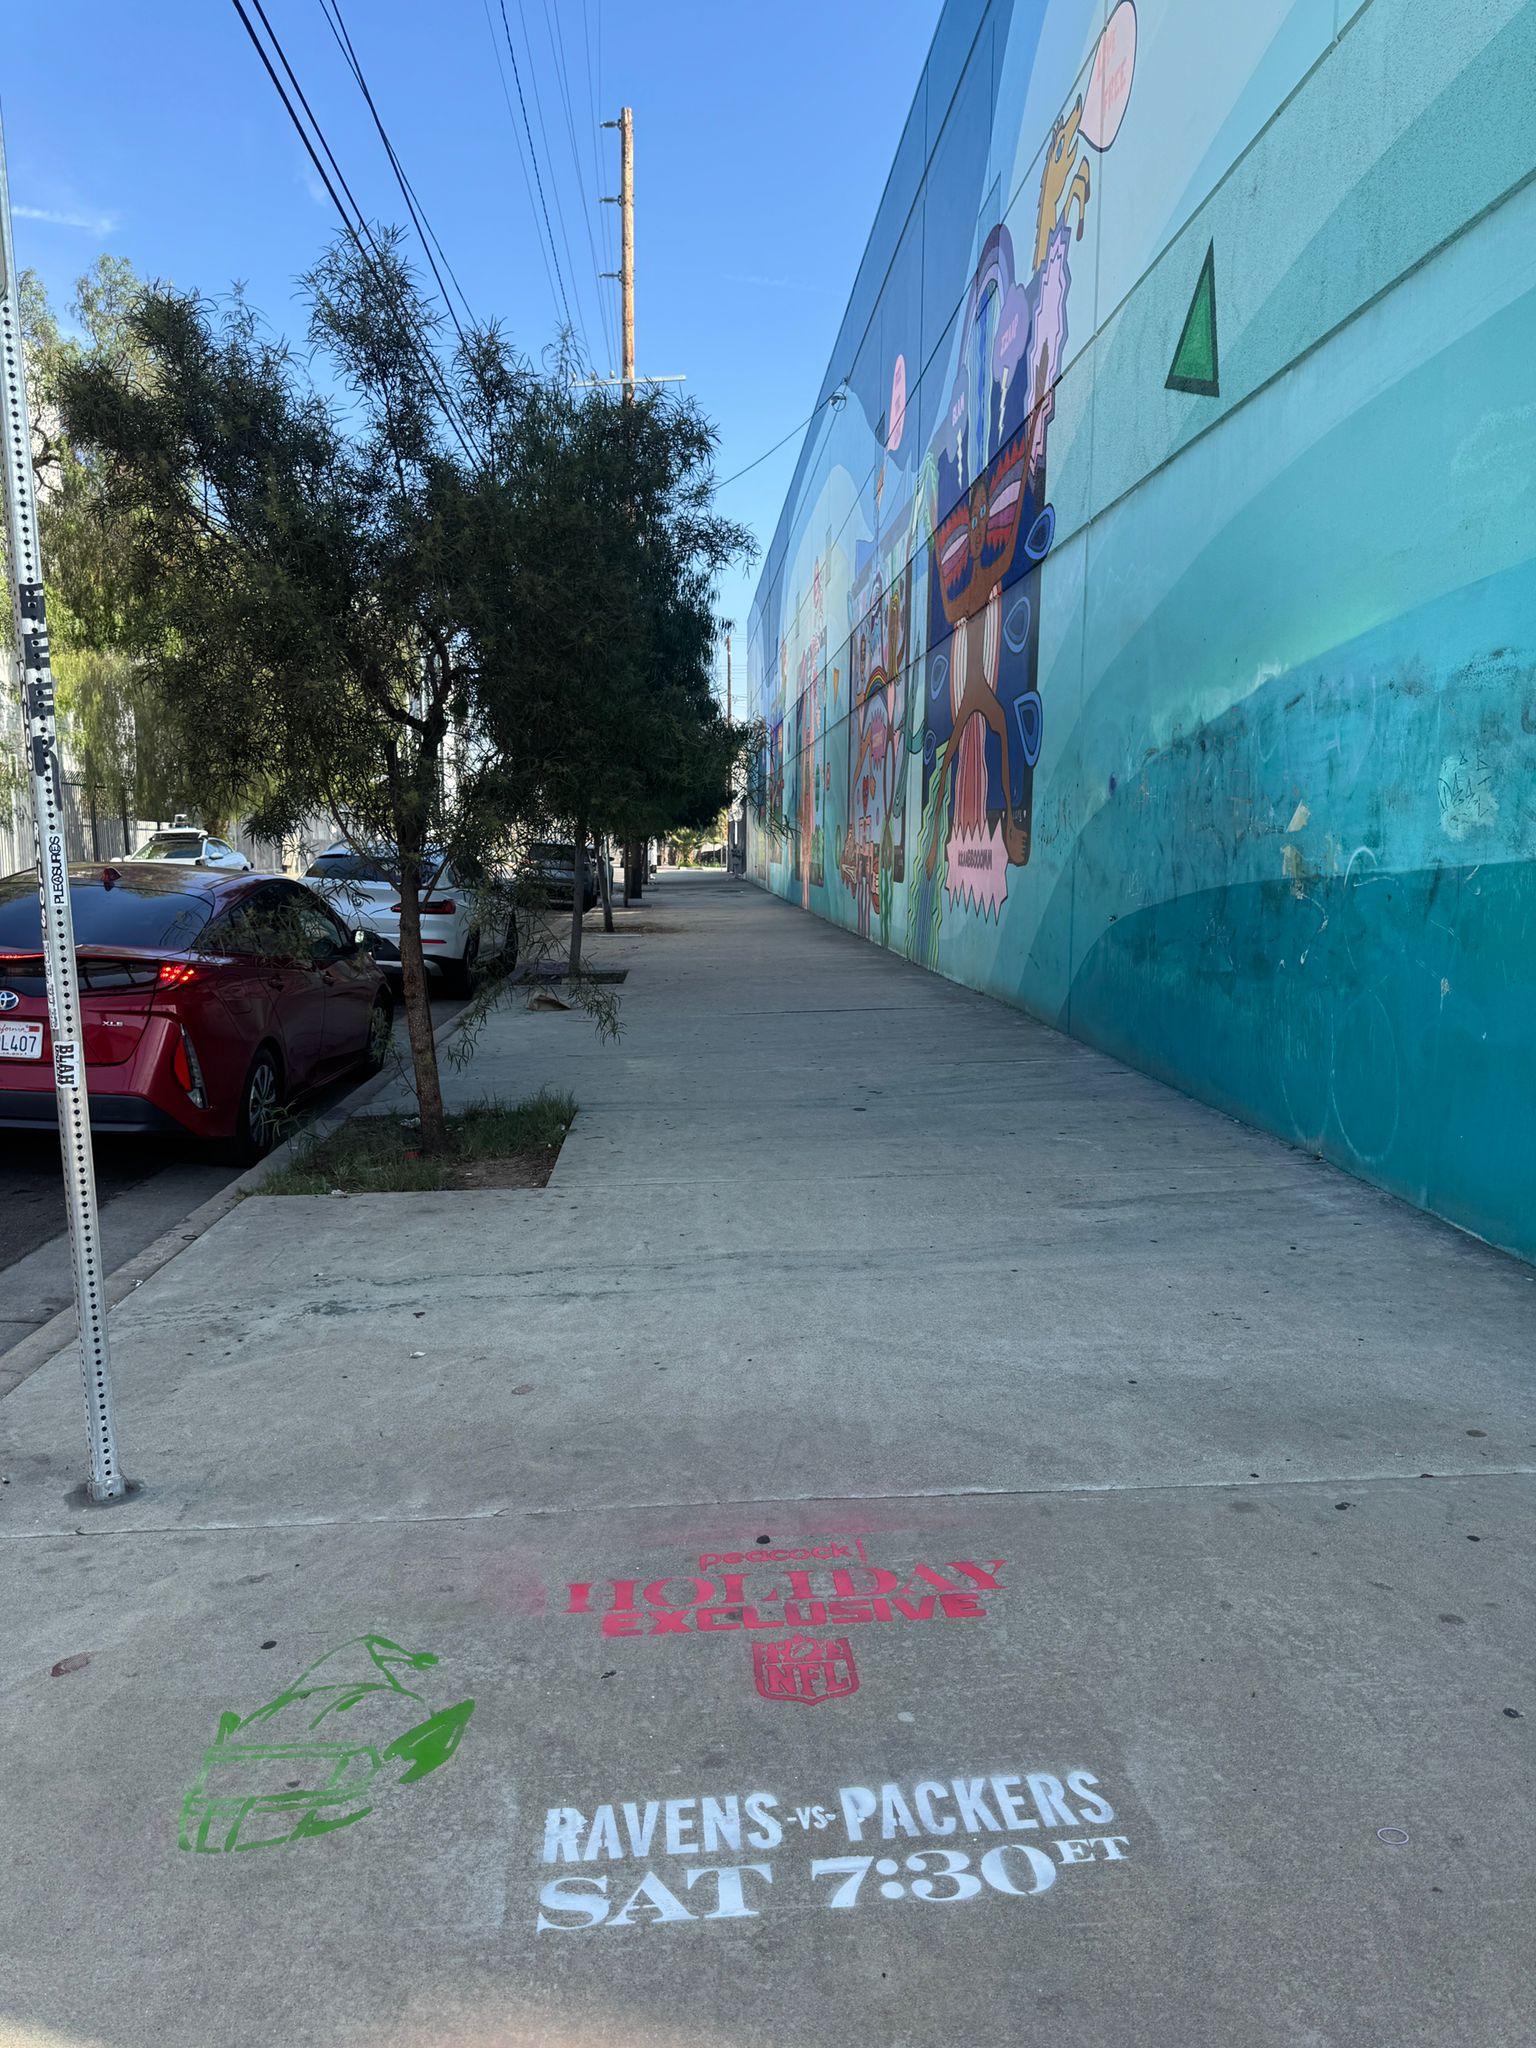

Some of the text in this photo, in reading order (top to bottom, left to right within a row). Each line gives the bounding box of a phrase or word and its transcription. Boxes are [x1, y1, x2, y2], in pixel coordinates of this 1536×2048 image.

[48, 835, 64, 904] PLEASURES
[59, 1044, 75, 1085] BLAH
[698, 1541, 853, 1572] peacock
[563, 1559, 1008, 1613] HOLIDAY
[602, 1592, 987, 1637] EXCLUSIVE
[766, 1660, 851, 1696] NFL
[541, 1792, 783, 1864] RAVENS
[838, 1770, 1116, 1842] PACKERS
[536, 1835, 1131, 1932] SAT 7:30 ET
